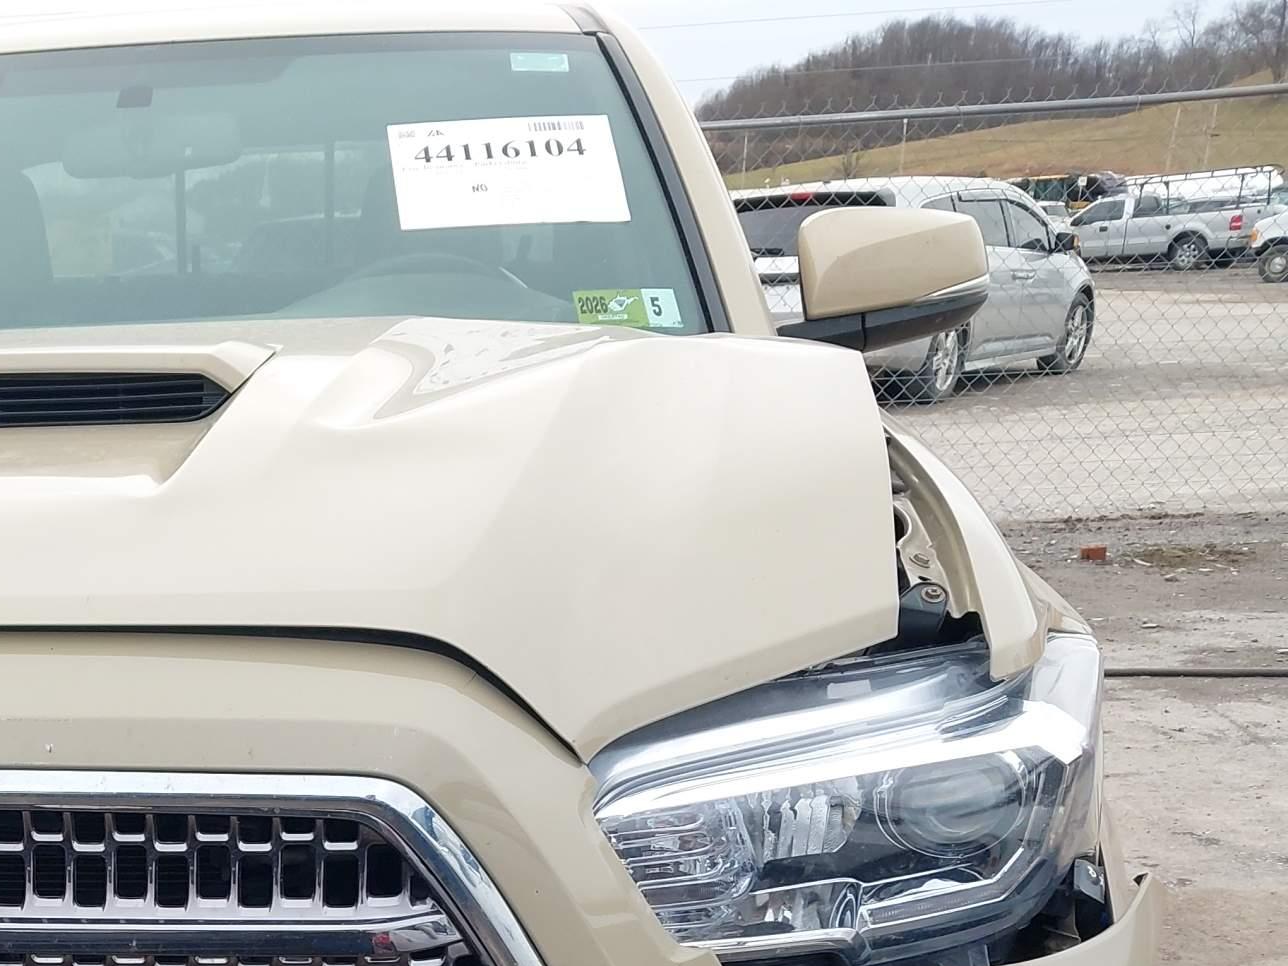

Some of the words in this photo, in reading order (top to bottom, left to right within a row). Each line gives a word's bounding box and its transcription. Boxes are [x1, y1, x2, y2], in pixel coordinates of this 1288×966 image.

[414, 138, 587, 163] 44116104
[578, 296, 609, 314] 2026
[650, 296, 663, 317] 5
